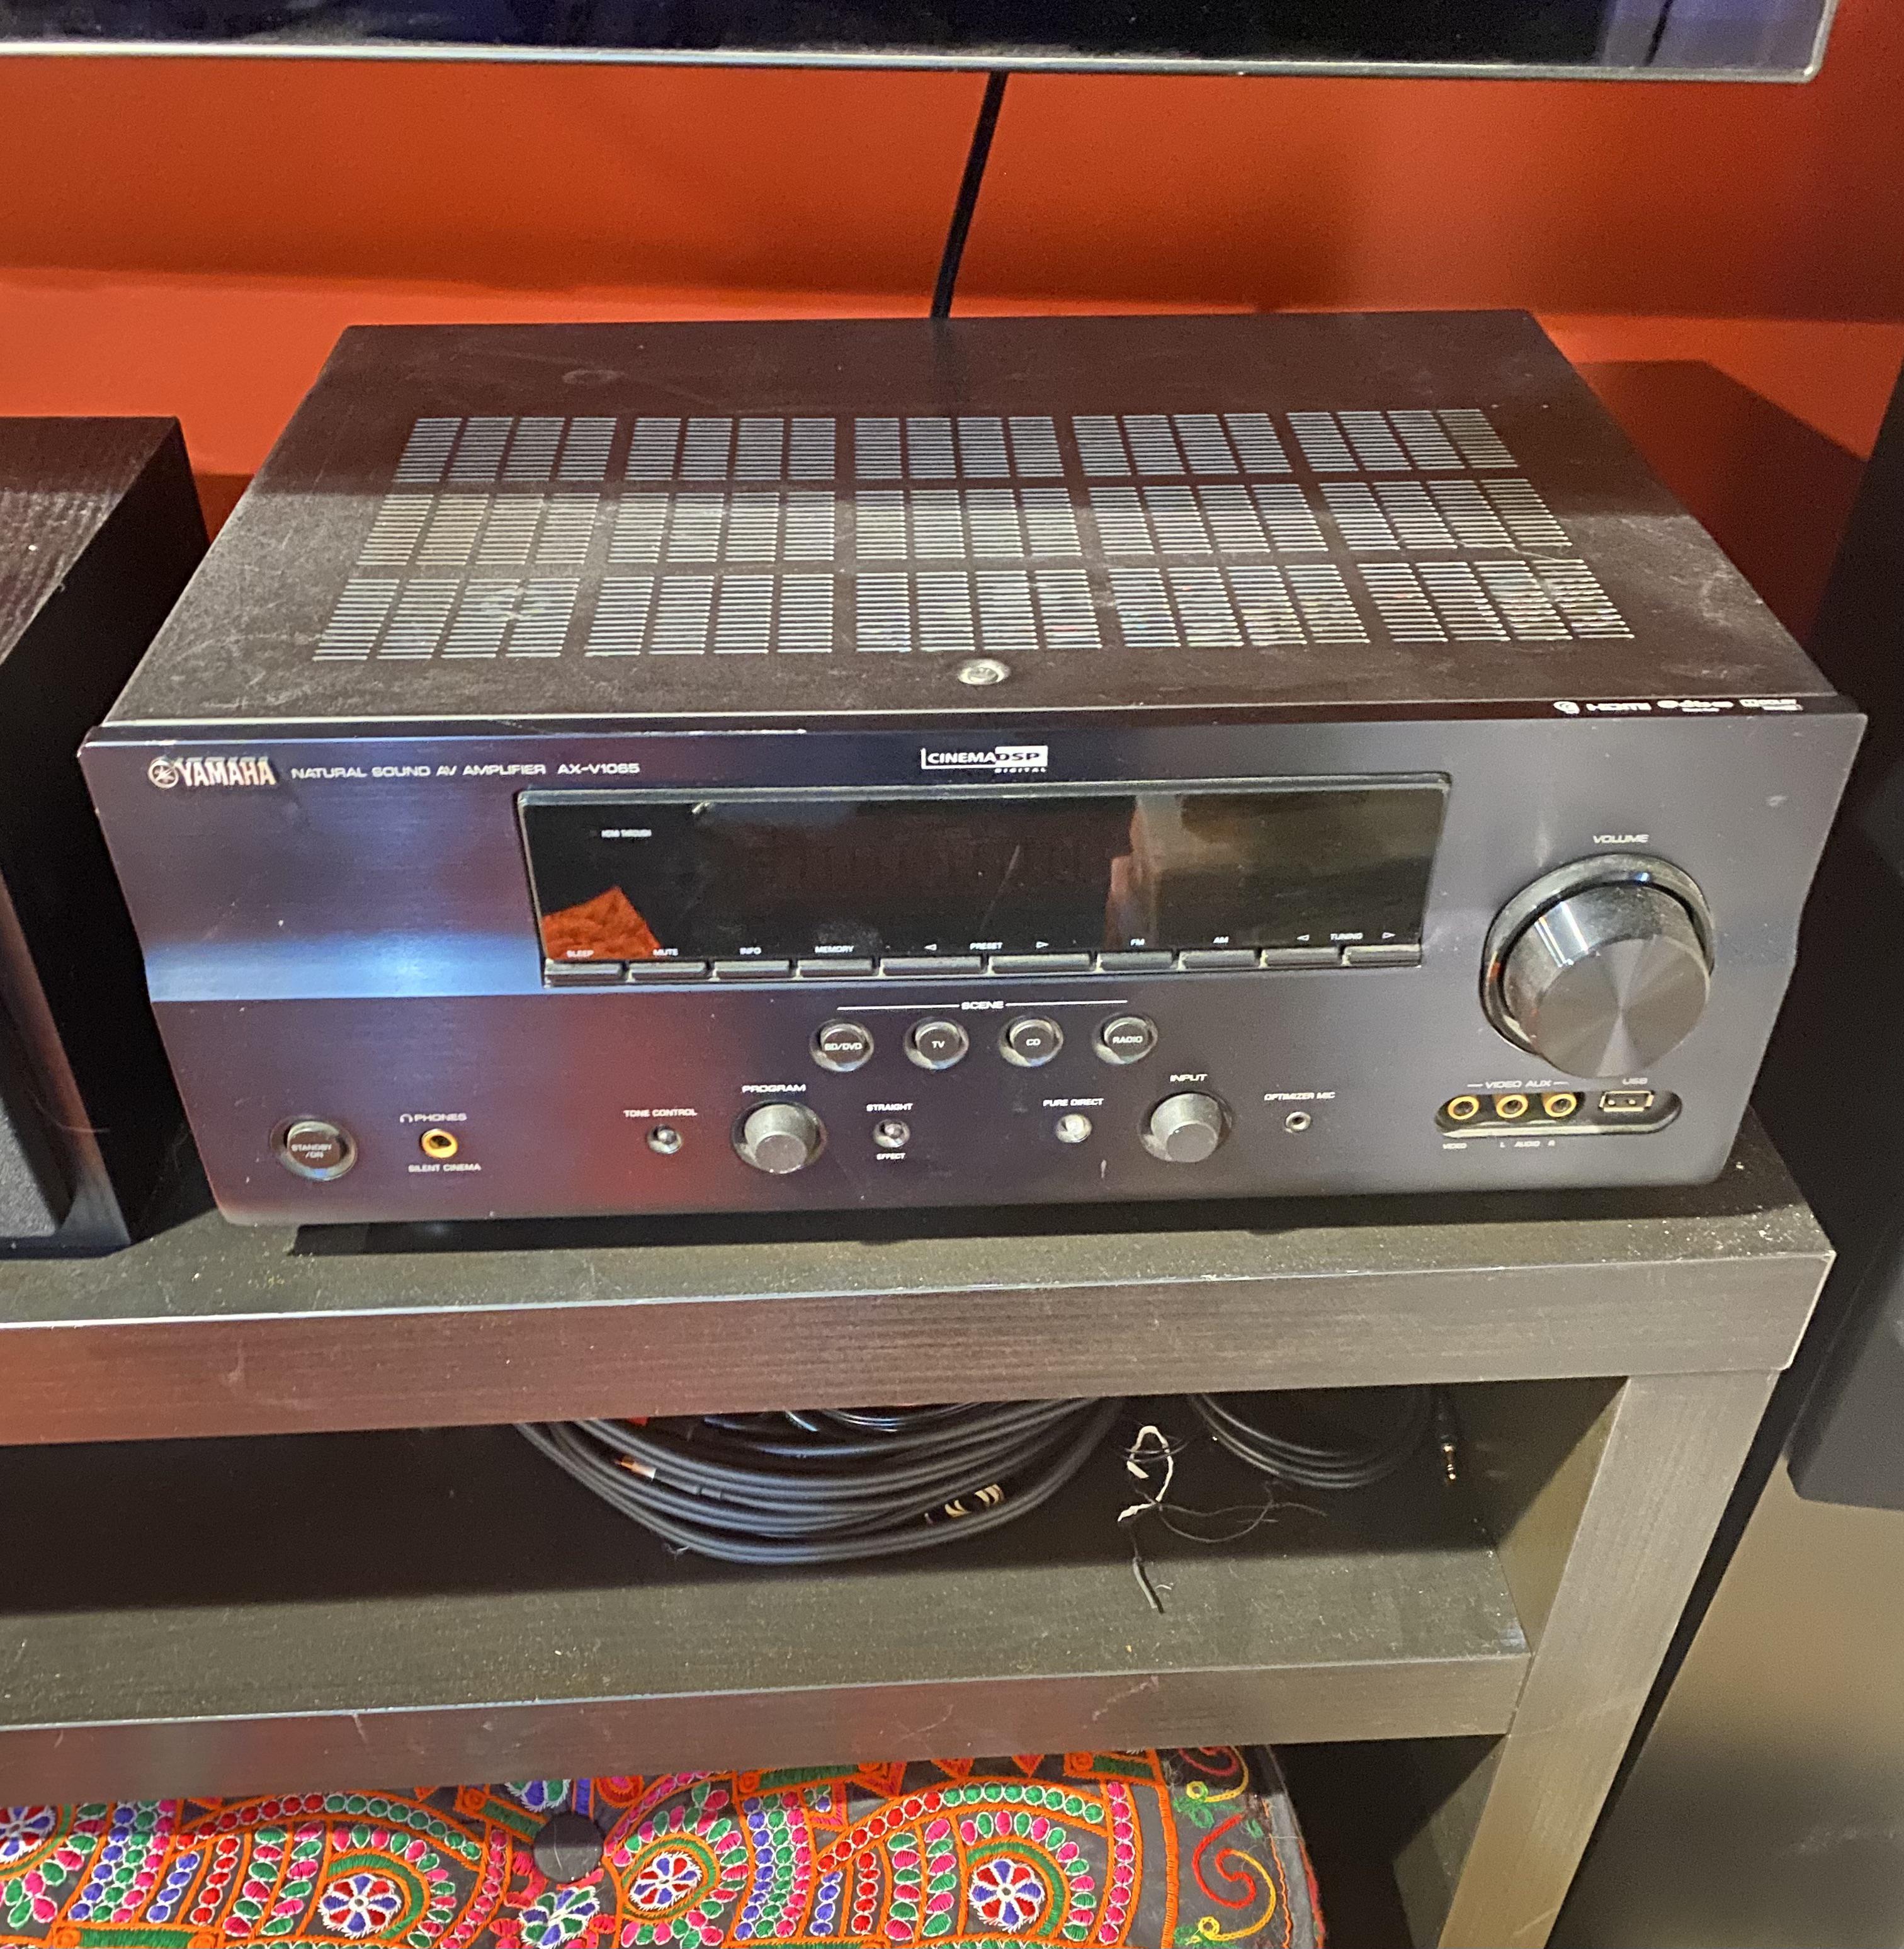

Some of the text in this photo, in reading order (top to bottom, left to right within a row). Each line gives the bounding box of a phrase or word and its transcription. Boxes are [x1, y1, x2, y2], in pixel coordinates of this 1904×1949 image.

[927, 753, 996, 764] CINEMA
[174, 756, 276, 786] YAMAHA
[291, 763, 640, 779] NATURAL SOUND AV AMPLIFIER AX-V1065
[1592, 834, 1649, 843] VOLUME
[815, 945, 854, 953] MEMORY
[970, 942, 1003, 950] PRESET
[740, 946, 761, 955] INFO
[961, 1001, 1004, 1009] SCENE
[824, 1043, 862, 1051] BD/DVD
[1170, 1074, 1208, 1082] INPUT
[742, 1084, 806, 1093] PROGRAM
[1485, 1081, 1522, 1089] VIDEO
[1264, 1093, 1314, 1101] OPTIMIZER
[866, 1103, 913, 1111] STRAIGHT
[652, 1108, 698, 1117] CONTROL
[414, 1113, 467, 1122] PHONES
[443, 1163, 482, 1171] CINEMA
